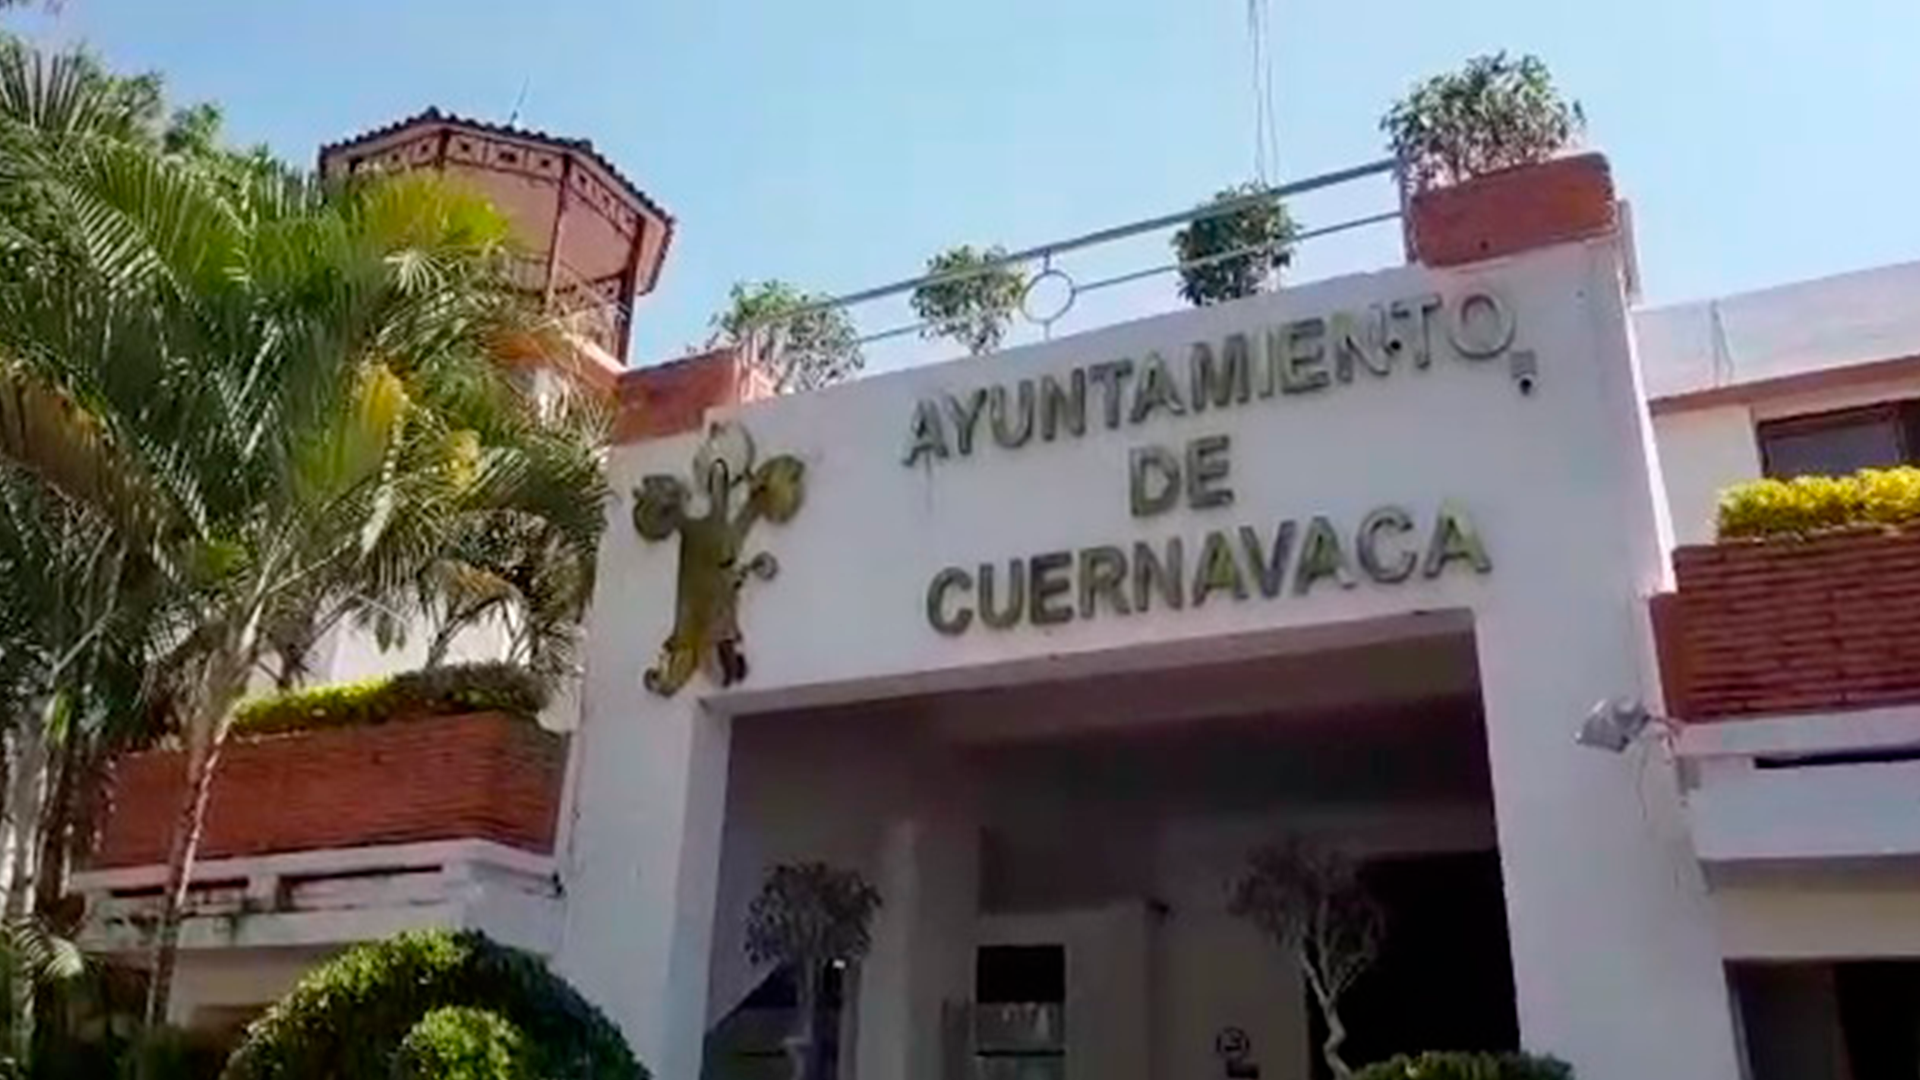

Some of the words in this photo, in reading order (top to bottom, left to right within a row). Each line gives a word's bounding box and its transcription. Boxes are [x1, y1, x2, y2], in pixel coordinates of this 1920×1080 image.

[902, 286, 1517, 467] AYUNTAMIENTO
[1129, 435, 1234, 517] DE
[926, 498, 1492, 636] CUERNAVACA
